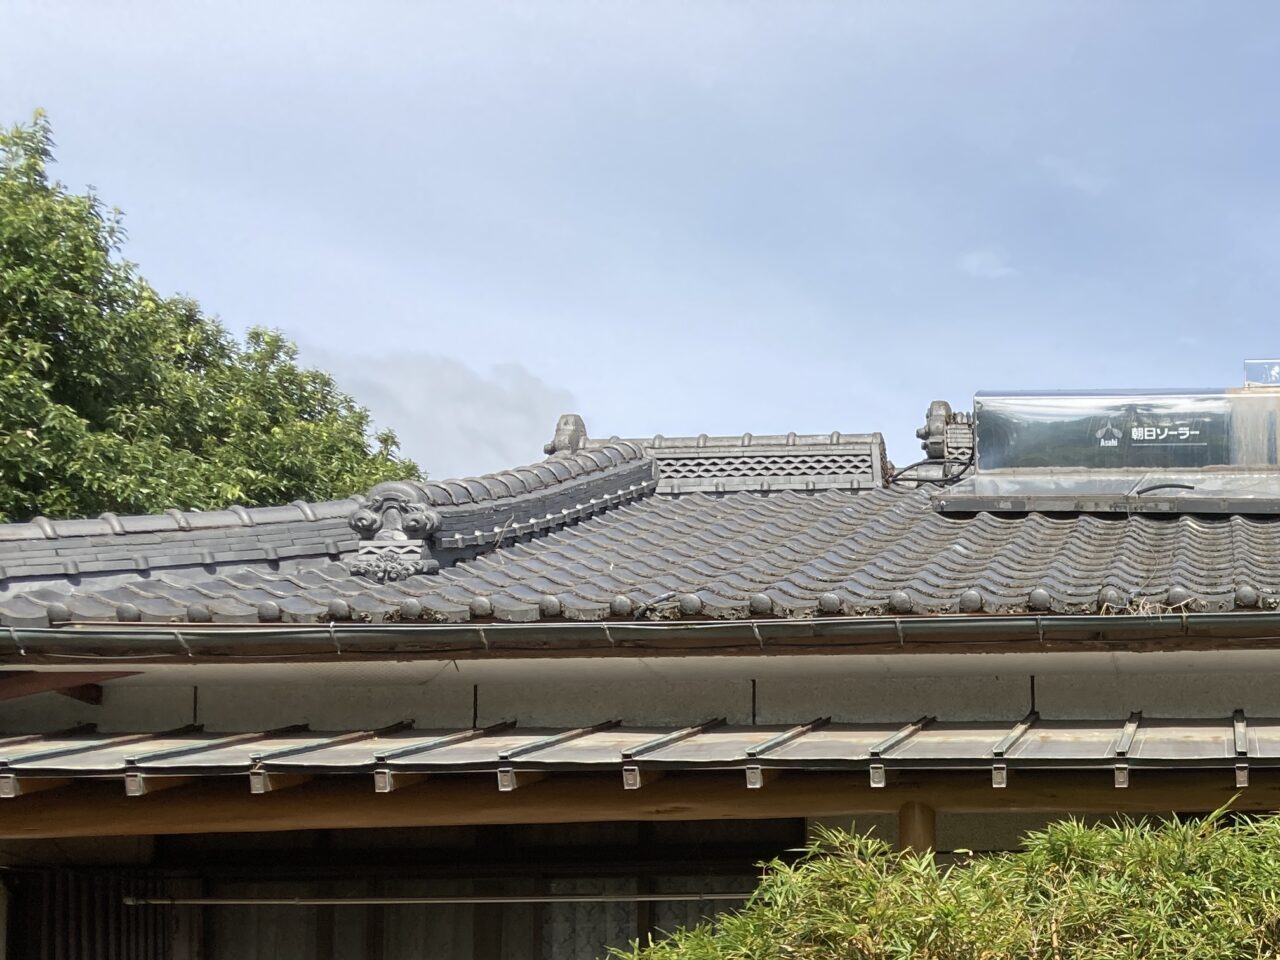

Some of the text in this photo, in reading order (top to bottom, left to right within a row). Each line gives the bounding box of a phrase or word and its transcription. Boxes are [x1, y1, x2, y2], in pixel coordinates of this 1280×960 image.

[1131, 427, 1200, 440] 朝日ソーラー
[1100, 438, 1118, 447] Asahi
